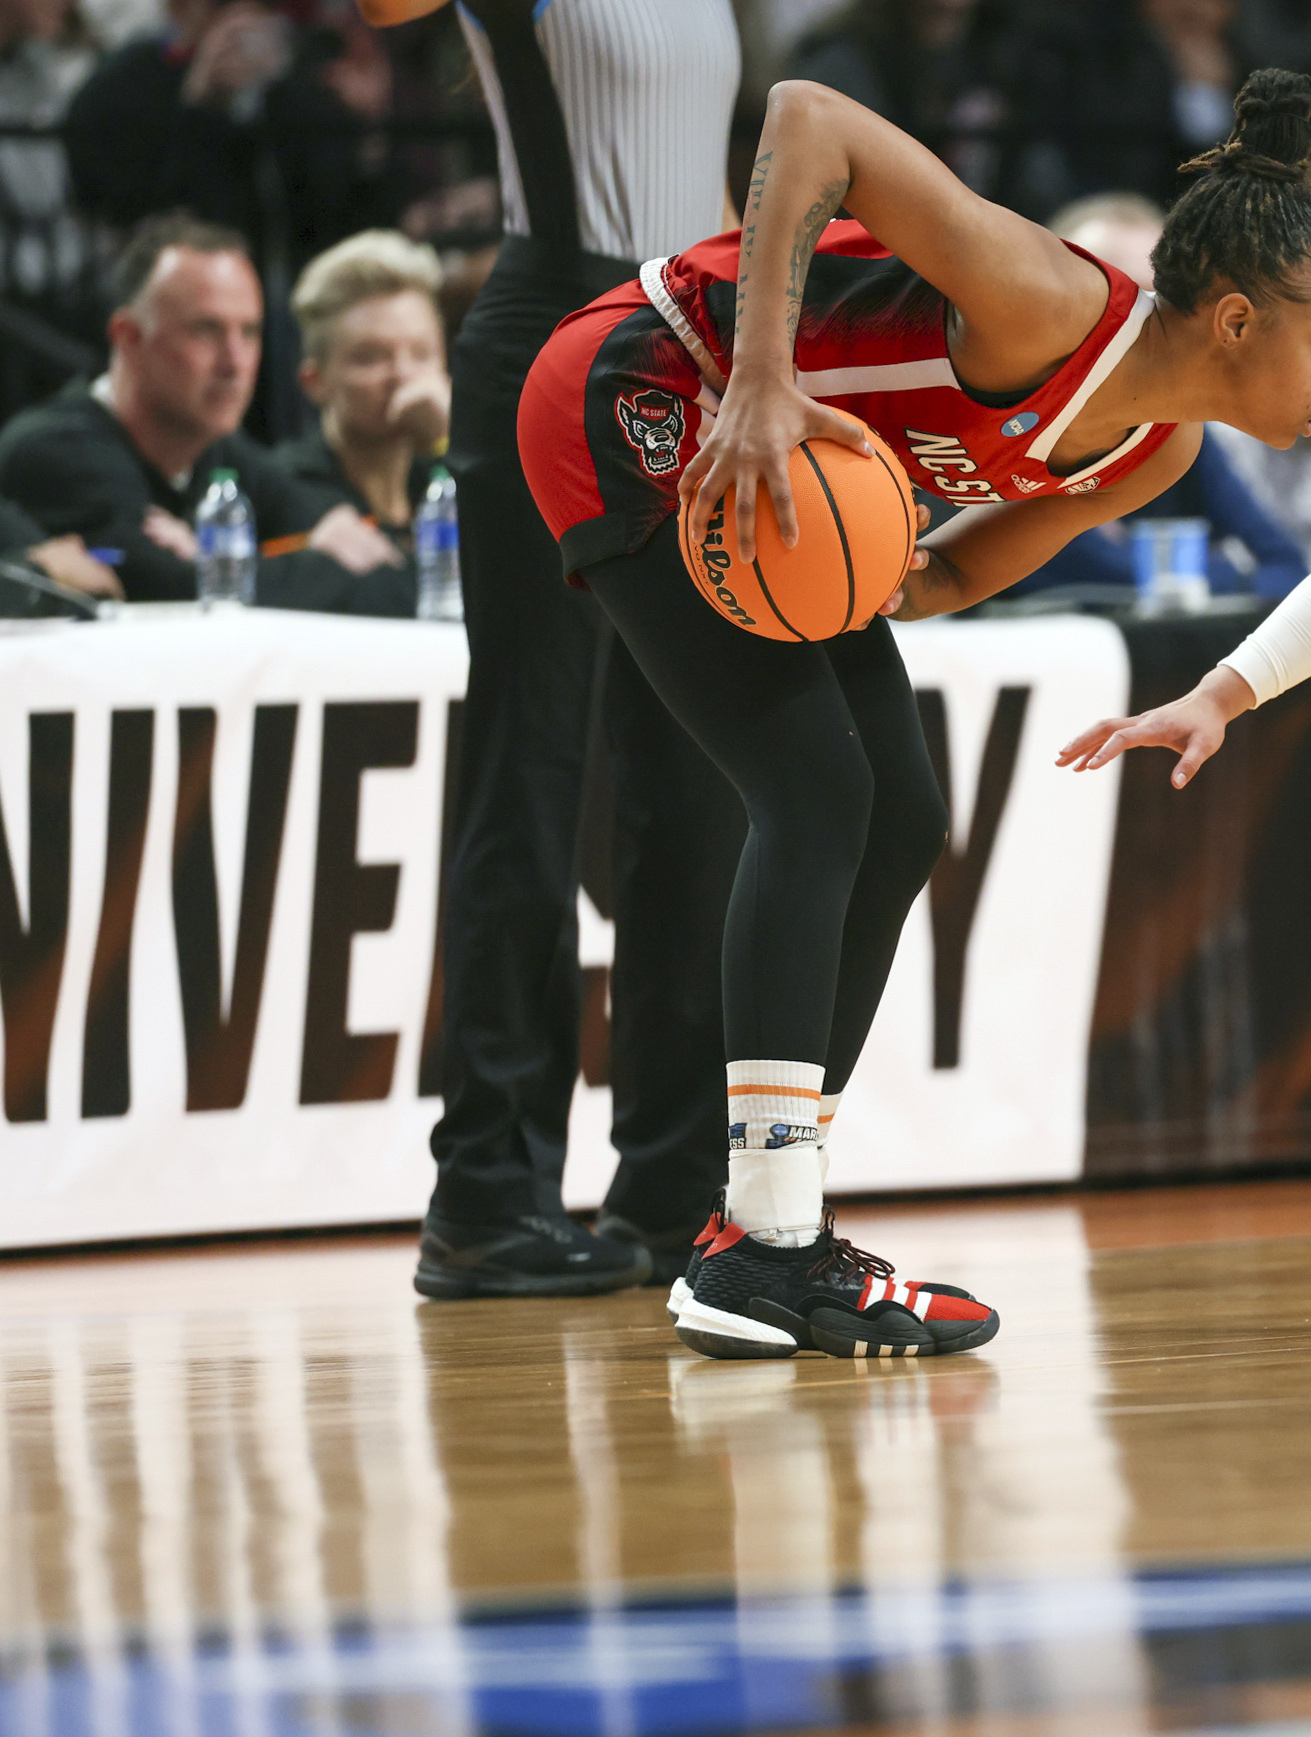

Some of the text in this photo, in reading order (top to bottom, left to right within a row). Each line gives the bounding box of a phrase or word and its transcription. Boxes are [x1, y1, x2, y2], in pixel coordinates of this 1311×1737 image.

[641, 407, 667, 417] NC STATE
[1008, 418, 1025, 436] NCAA
[789, 1126, 819, 1140] MAR
